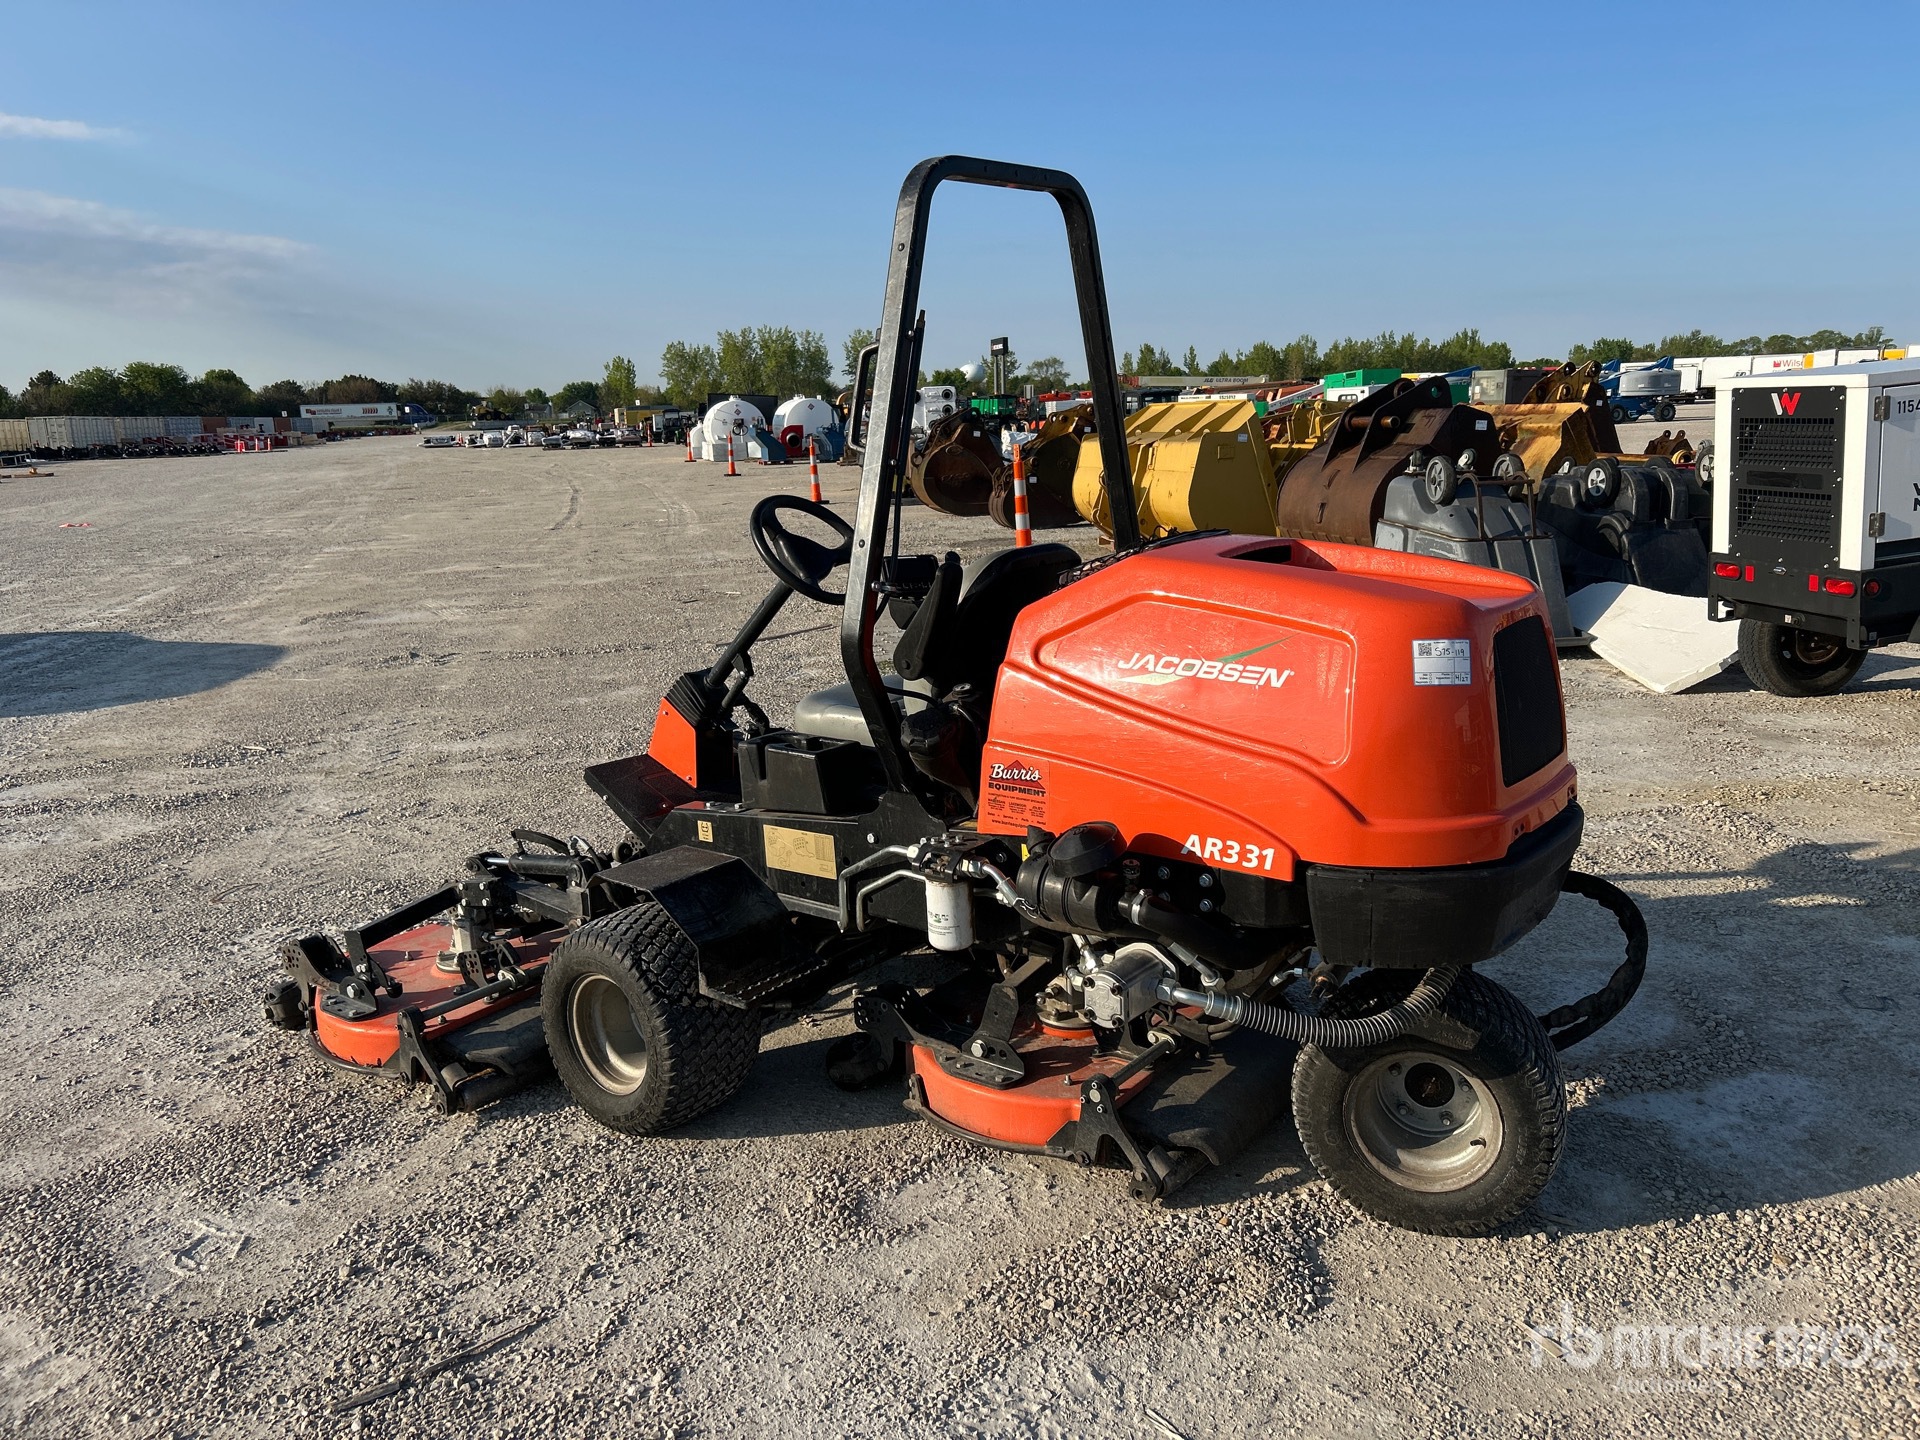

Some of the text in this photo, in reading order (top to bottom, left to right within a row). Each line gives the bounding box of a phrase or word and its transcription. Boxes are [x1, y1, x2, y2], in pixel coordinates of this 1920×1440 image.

[1117, 652, 1290, 688] JACOBSEN
[989, 763, 1042, 781] Burris
[988, 782, 1046, 797] EQUIPMENT
[1180, 834, 1275, 871] AR331
